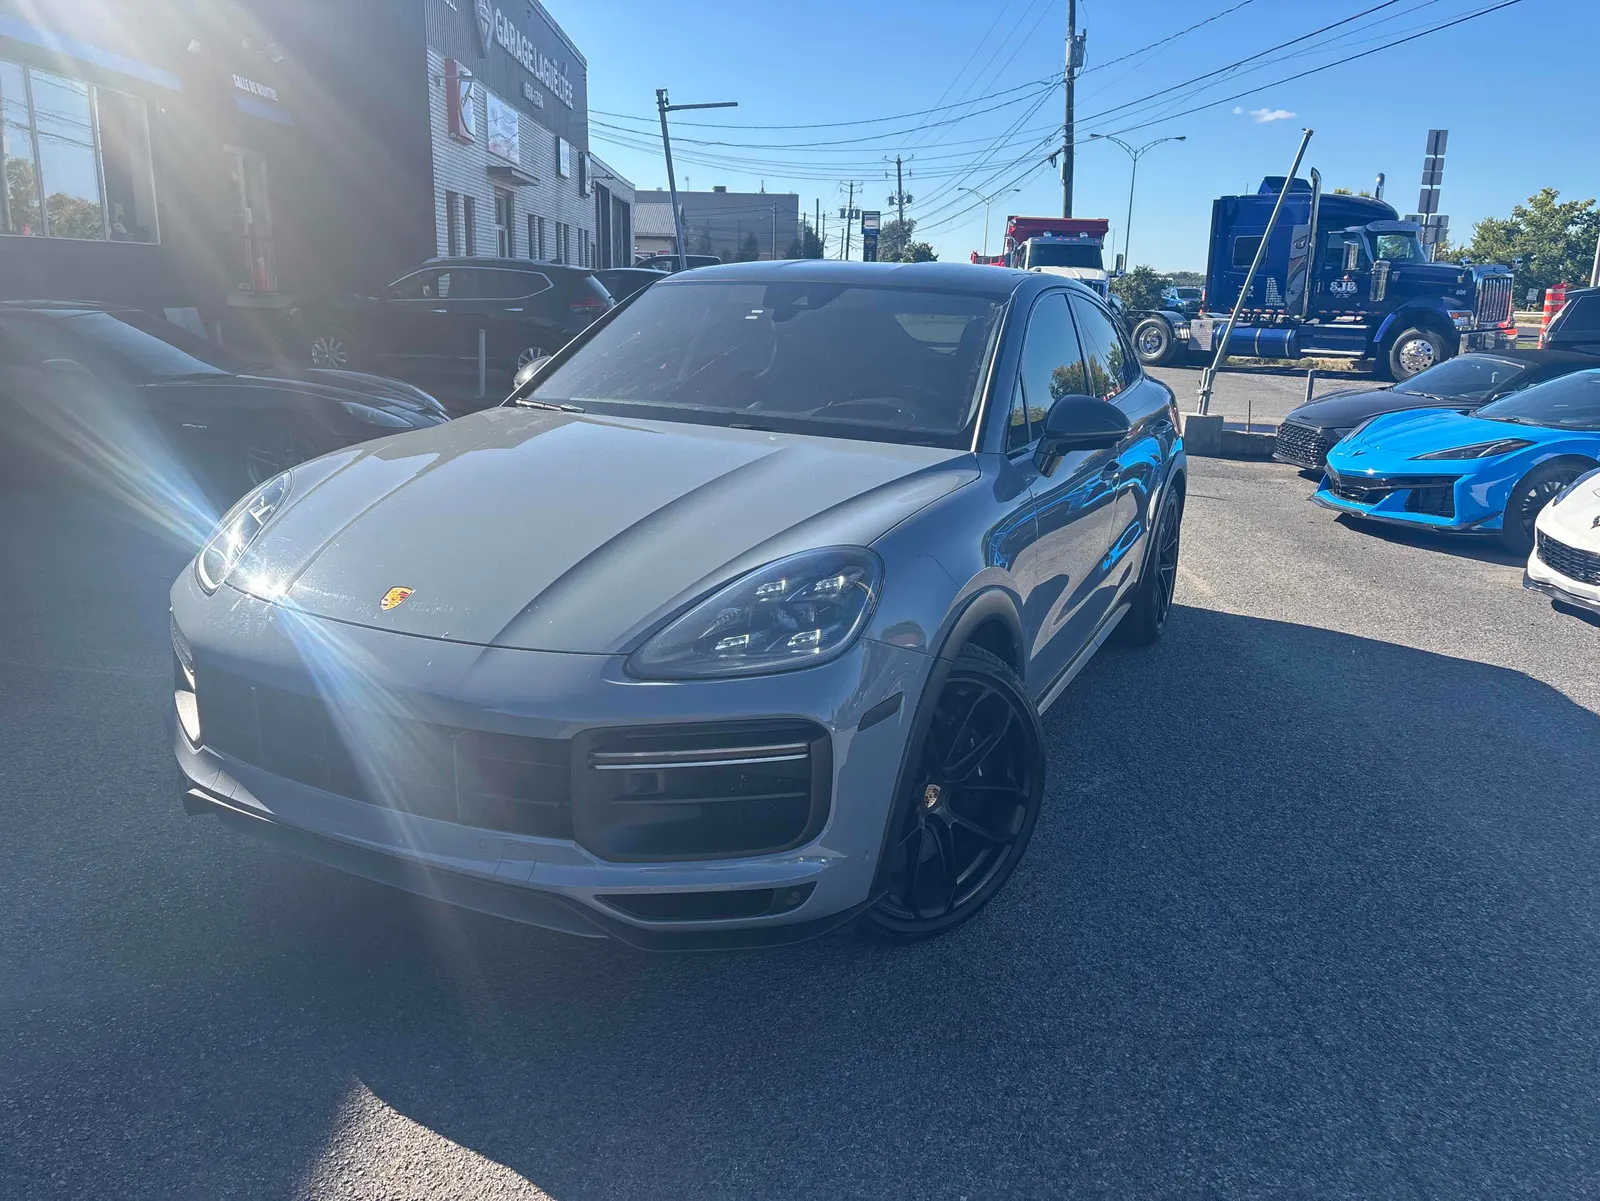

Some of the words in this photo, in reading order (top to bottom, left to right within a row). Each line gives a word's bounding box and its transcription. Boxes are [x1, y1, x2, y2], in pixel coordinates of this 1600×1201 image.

[495, 8, 535, 74] GARAGE
[233, 74, 250, 91] SALLE
[249, 81, 257, 94] DE
[1329, 281, 1357, 293] SJB
